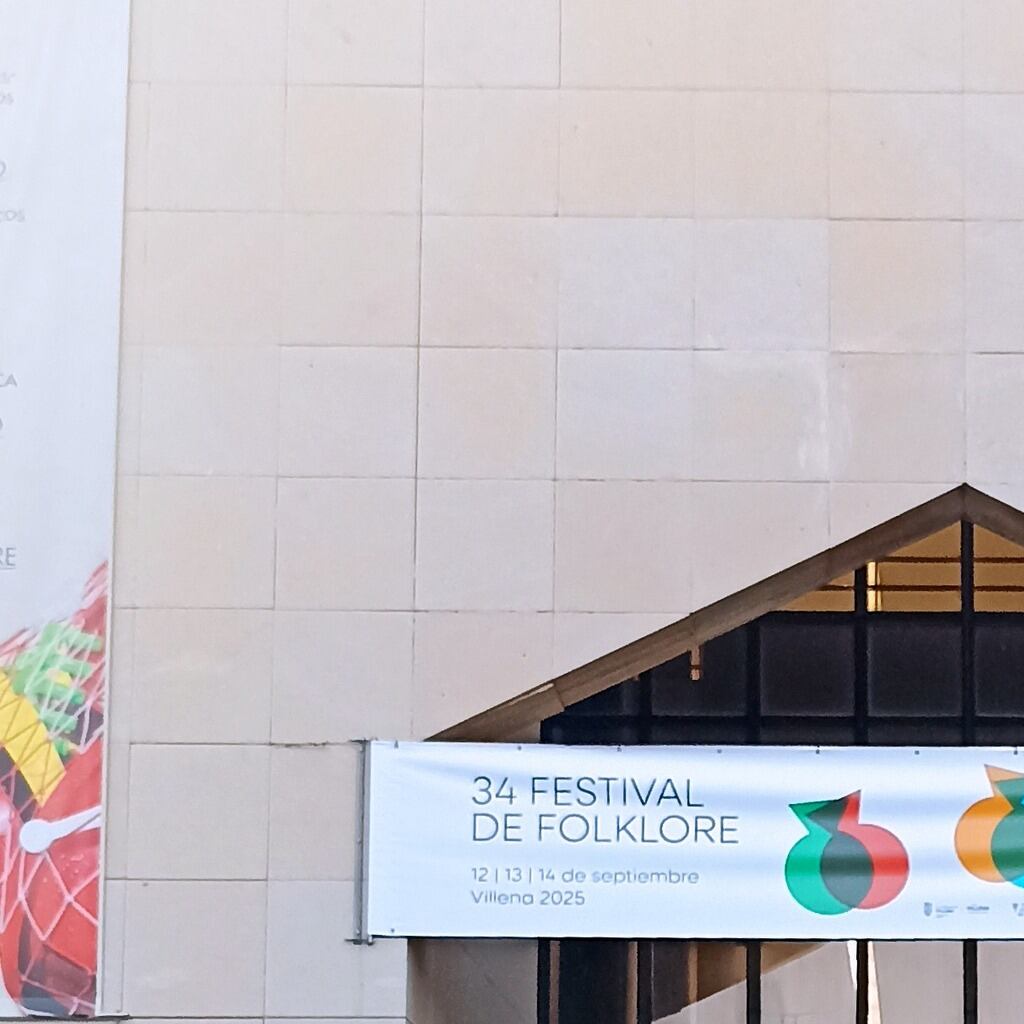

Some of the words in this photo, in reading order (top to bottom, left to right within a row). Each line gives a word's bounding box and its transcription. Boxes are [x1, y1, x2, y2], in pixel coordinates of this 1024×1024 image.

[471, 776, 517, 806] 34
[531, 776, 705, 807] FESTIVAL
[472, 813, 523, 842] DE
[538, 814, 739, 844] FOLKLORE
[471, 867, 489, 882] 12
[505, 867, 522, 883] 13
[538, 868, 556, 882] 14
[561, 867, 587, 884] de
[591, 868, 700, 885] septiembre
[471, 890, 535, 906] Villena
[539, 890, 586, 906] 2025
